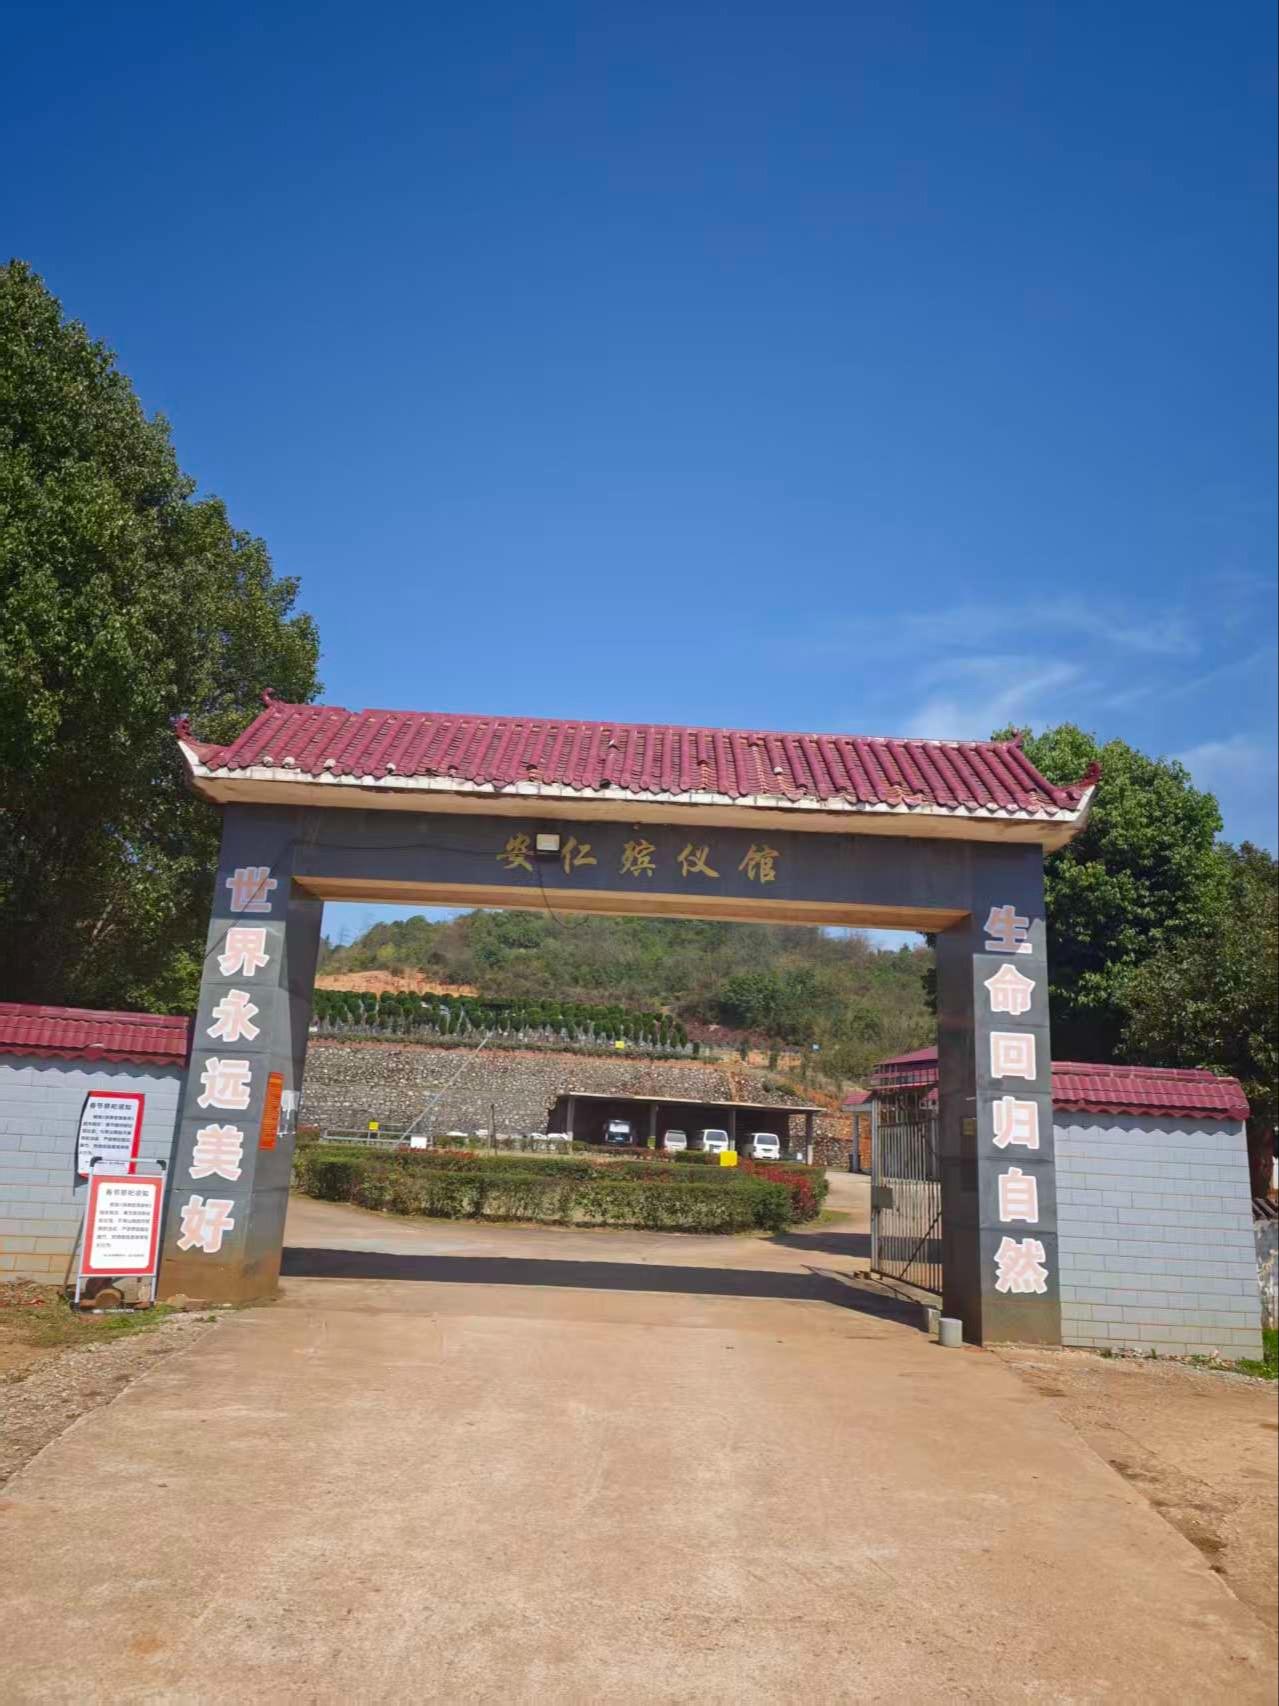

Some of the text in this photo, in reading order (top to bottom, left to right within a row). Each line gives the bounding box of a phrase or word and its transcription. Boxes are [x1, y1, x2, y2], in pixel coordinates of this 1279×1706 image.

[496, 831, 782, 884] 安仁殡仪馆
[177, 866, 278, 1254] 世界永远美好
[984, 904, 1048, 1295] 生命回归自然
